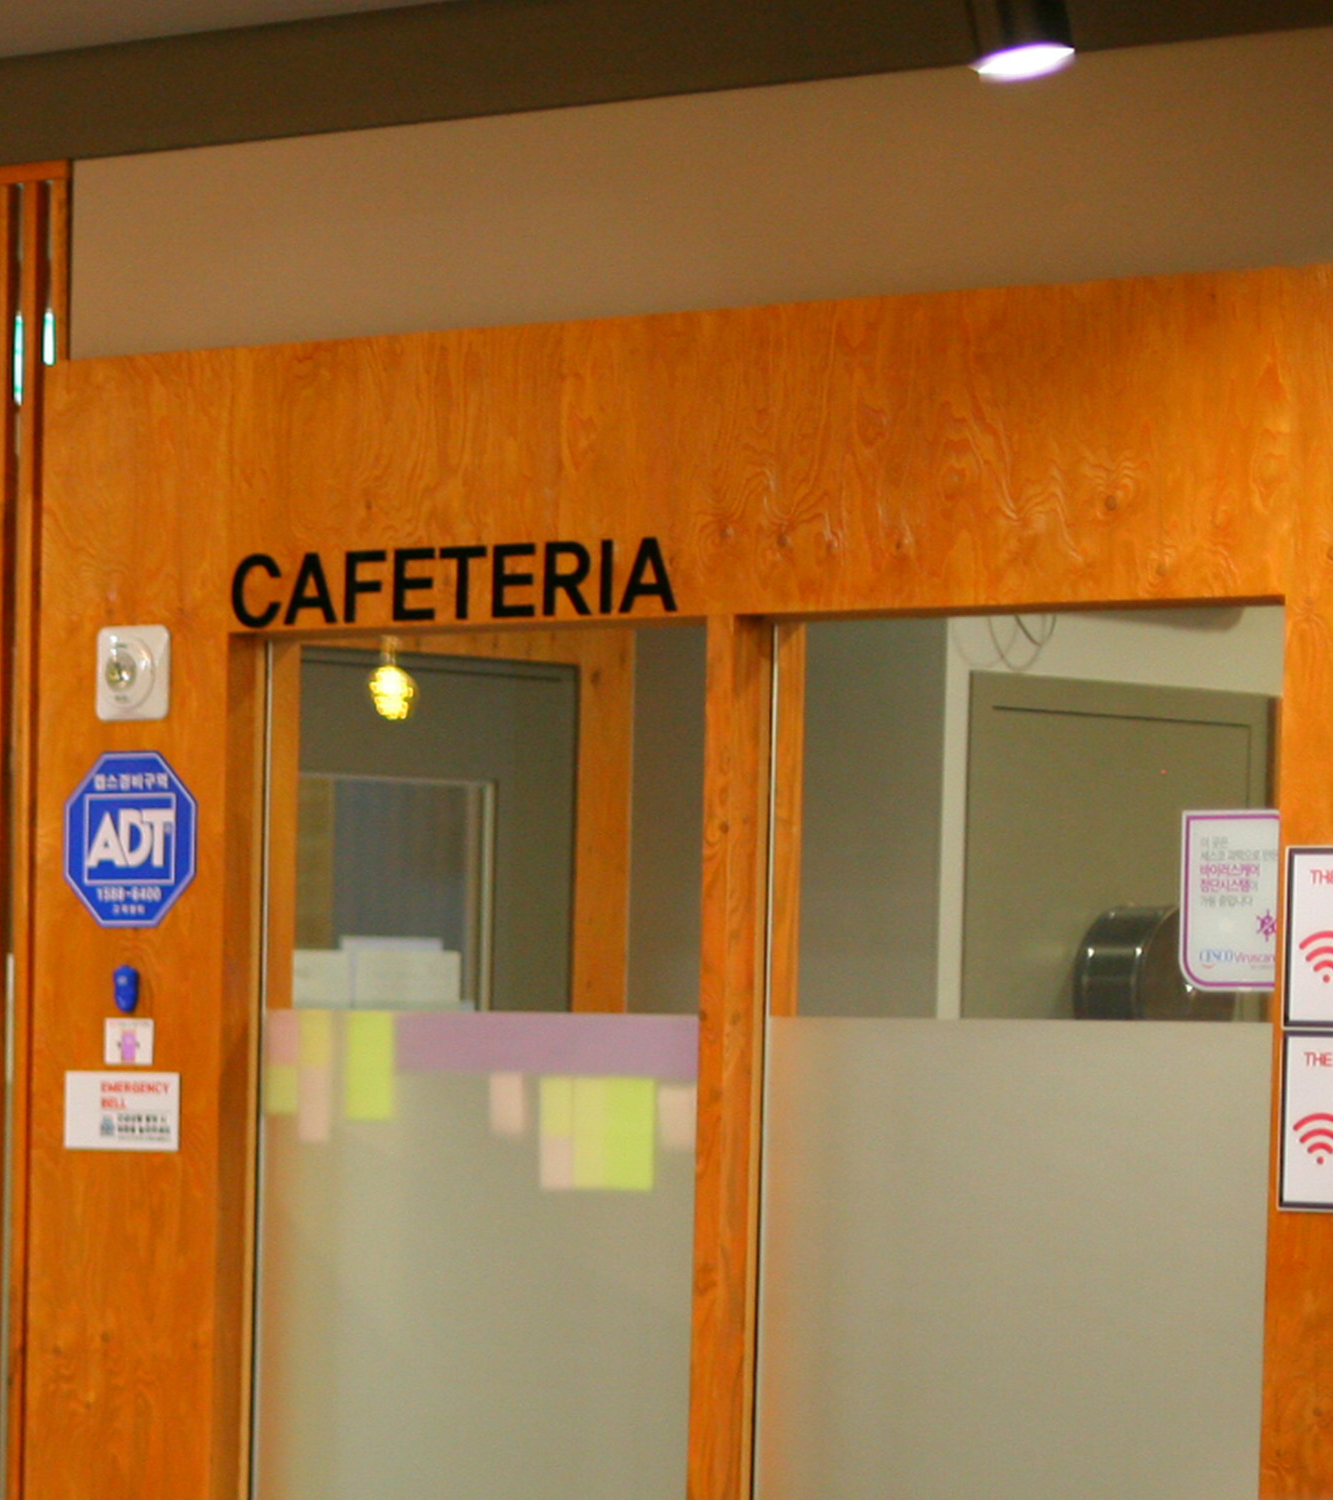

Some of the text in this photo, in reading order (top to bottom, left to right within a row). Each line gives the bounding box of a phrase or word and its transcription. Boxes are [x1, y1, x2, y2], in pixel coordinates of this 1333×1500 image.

[232, 537, 678, 628] CAFETERIA
[87, 808, 175, 868] ADT
[1200, 863, 1260, 877] 바이러스케어
[1303, 1051, 1332, 1067] THE
[101, 1081, 170, 1093] EMERGENCY
[101, 1097, 126, 1109] BELL
